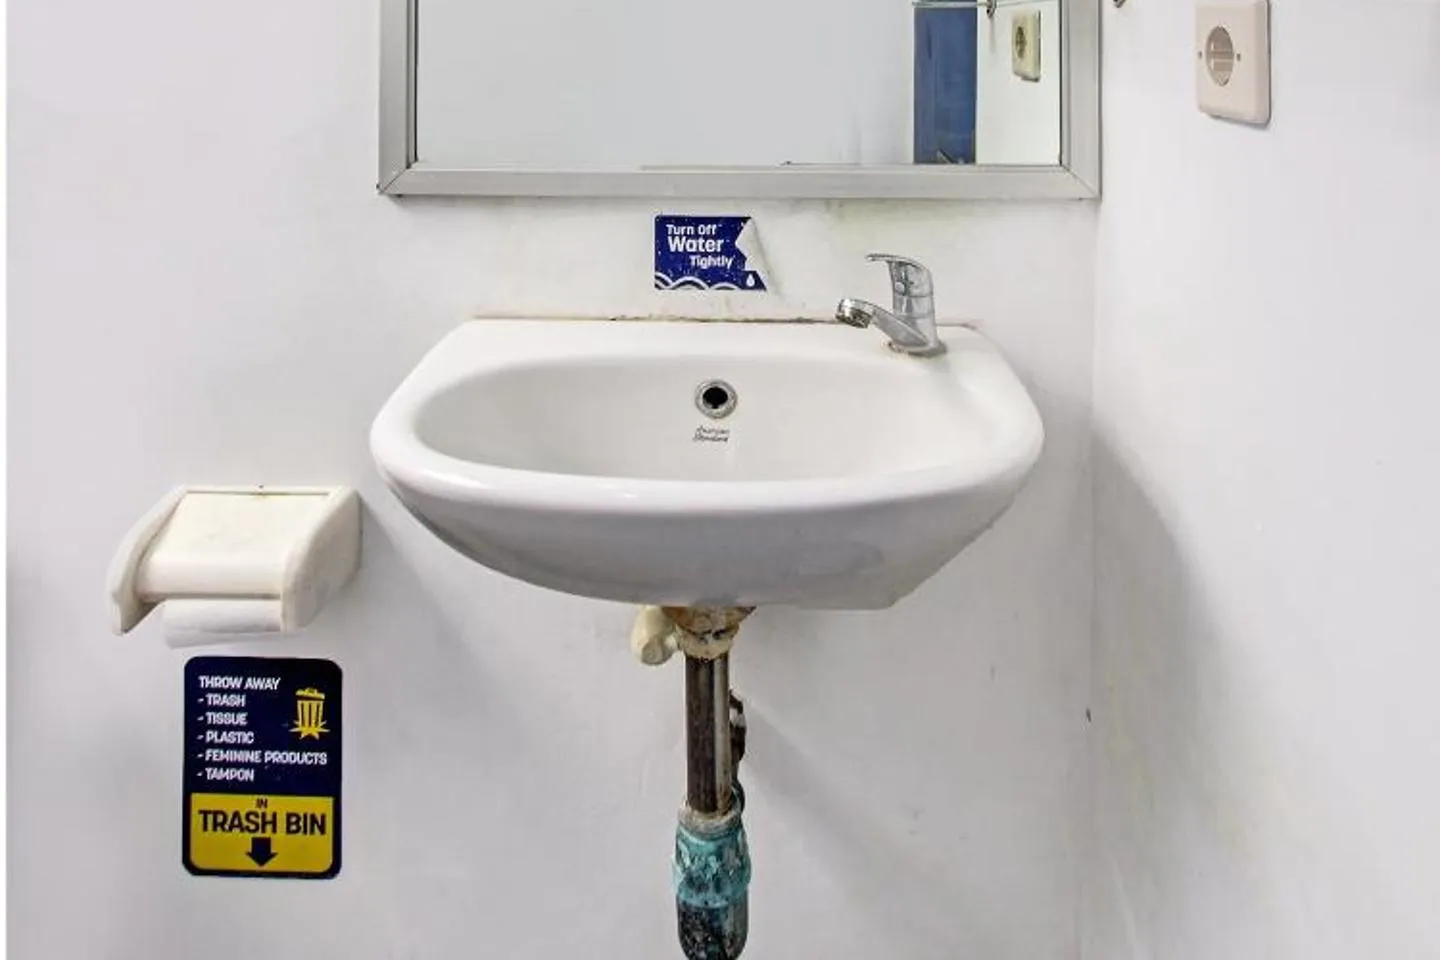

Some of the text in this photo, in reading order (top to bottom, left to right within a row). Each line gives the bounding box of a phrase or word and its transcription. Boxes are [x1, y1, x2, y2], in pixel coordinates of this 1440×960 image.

[666, 224, 717, 235] Turn Off
[667, 236, 725, 253] Water
[689, 255, 735, 270] Tightly
[198, 675, 281, 691] THROW AWAY
[206, 693, 246, 707] TRASH
[206, 712, 249, 726] TISSUE
[205, 730, 255, 745] PLASTIC
[205, 749, 328, 765] FEMININE PRODUCTS
[205, 768, 255, 782] TAMPON
[256, 798, 268, 809] IN
[198, 809, 327, 836] TRASH BIN
